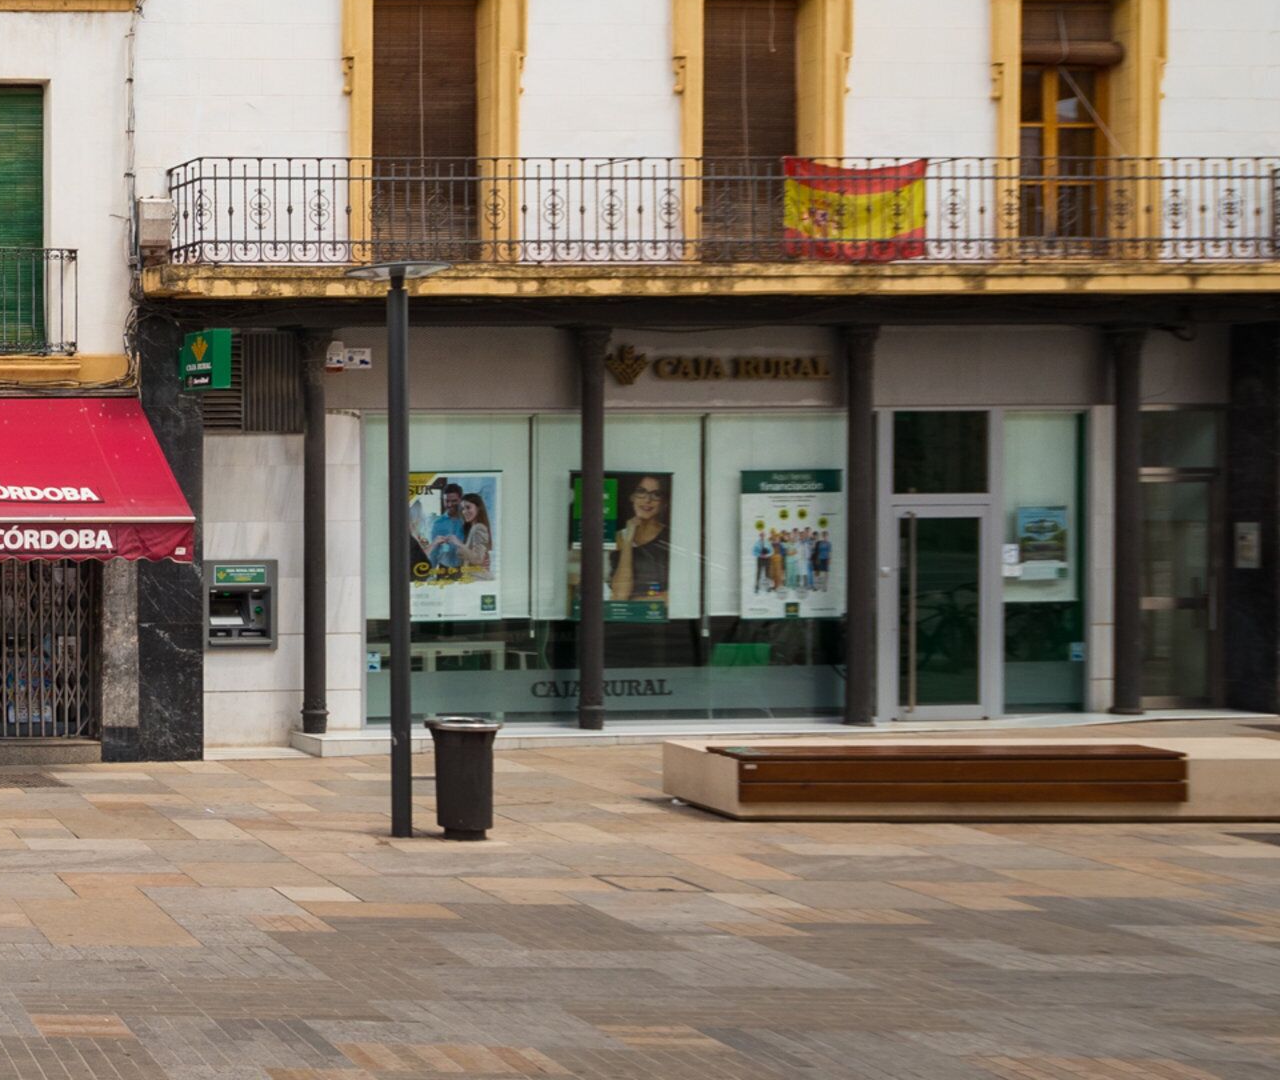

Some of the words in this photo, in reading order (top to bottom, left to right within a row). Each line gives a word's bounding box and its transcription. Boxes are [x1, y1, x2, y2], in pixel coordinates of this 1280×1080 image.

[655, 356, 725, 380] CAJA
[733, 356, 832, 380] RURAL
[531, 680, 581, 699] CAJA
[603, 678, 673, 697] RURAL
